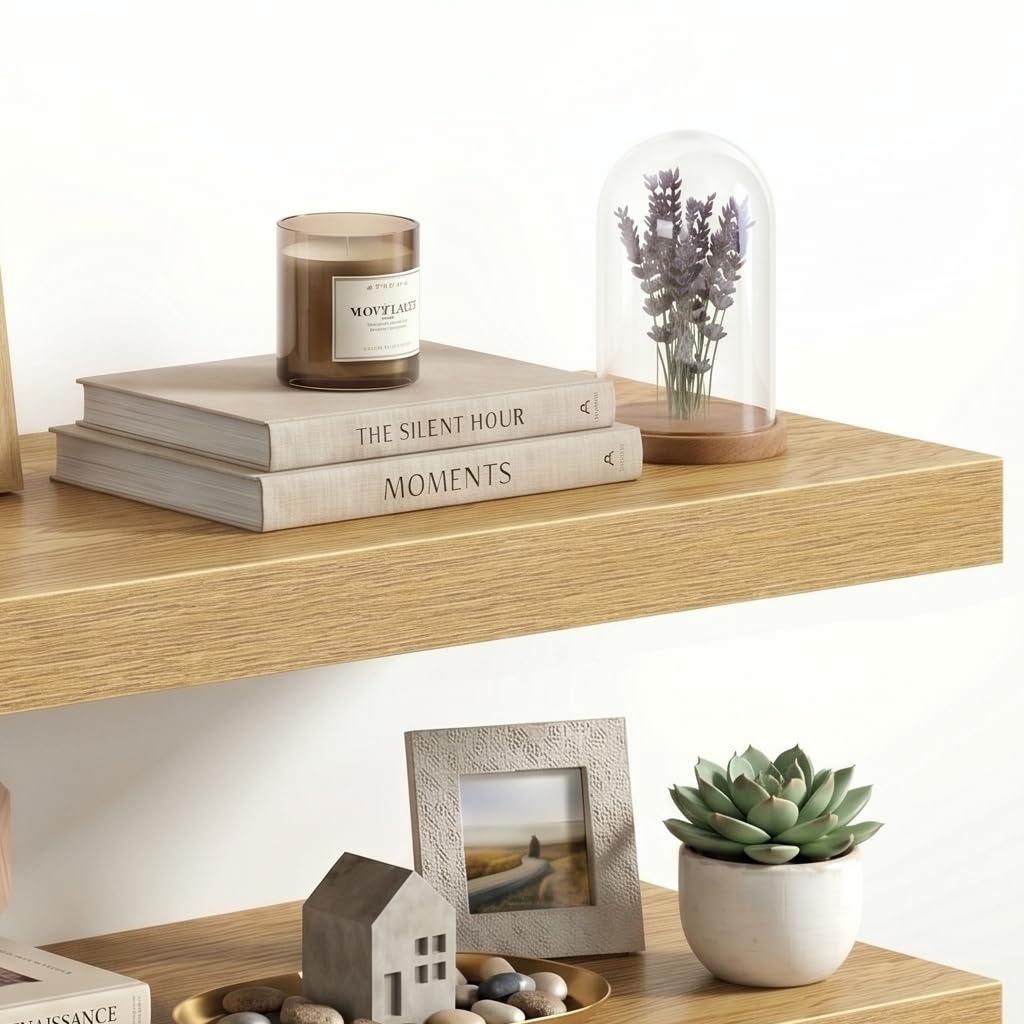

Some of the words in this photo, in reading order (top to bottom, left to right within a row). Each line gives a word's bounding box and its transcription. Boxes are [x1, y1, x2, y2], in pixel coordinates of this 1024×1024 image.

[356, 424, 393, 445] THE
[399, 415, 464, 441] SILENT
[471, 408, 524, 431] HOUR
[384, 461, 511, 501] MOMENTS
